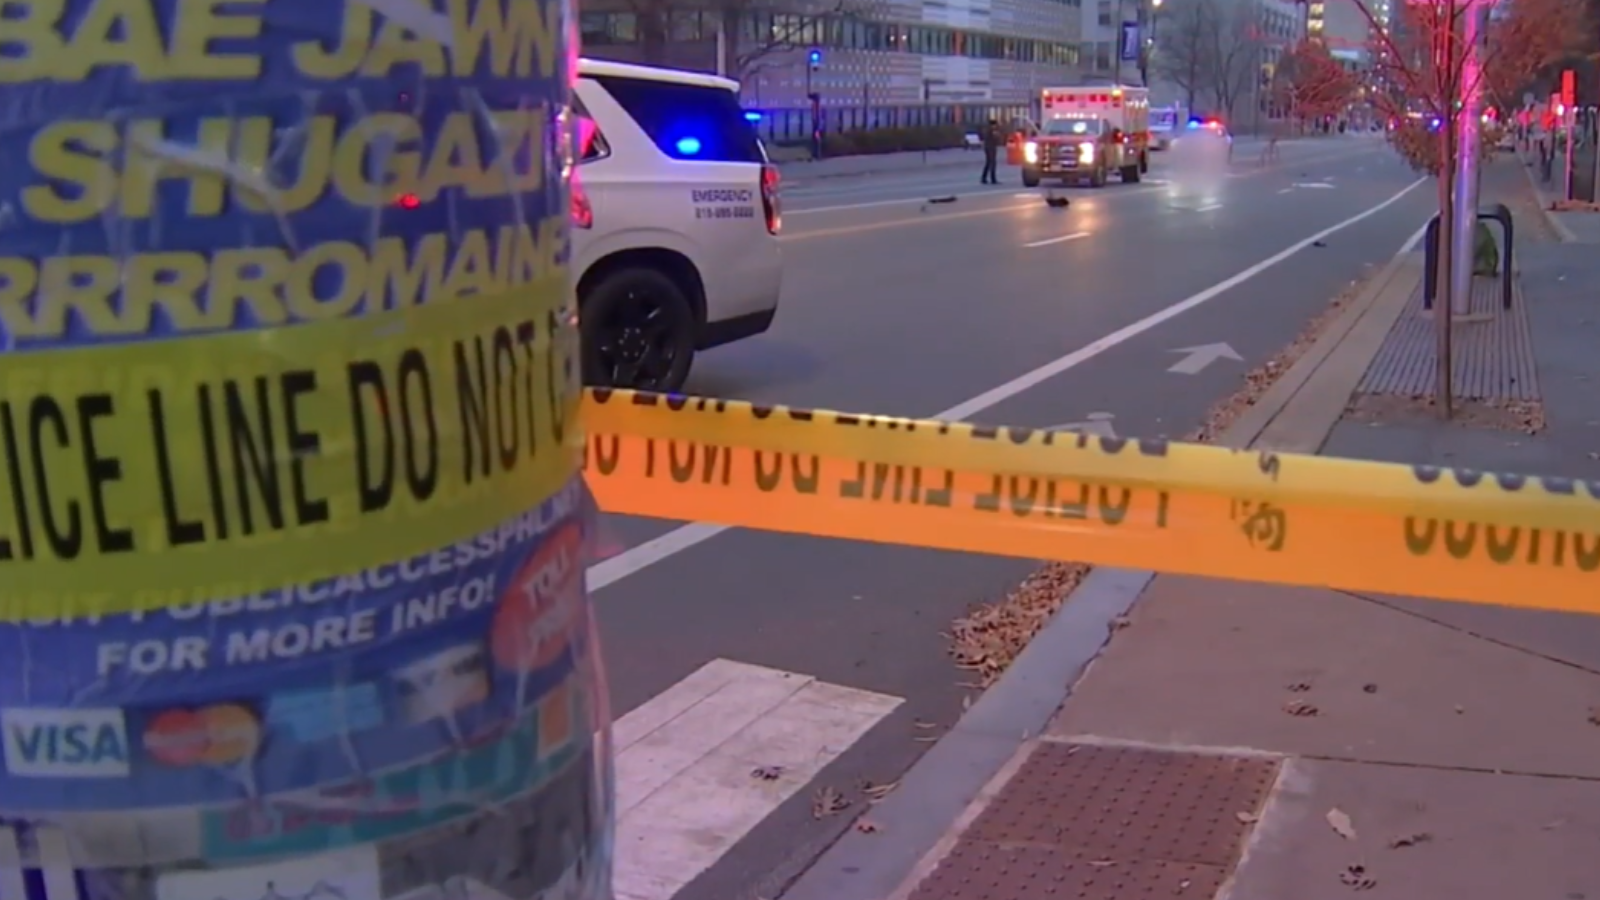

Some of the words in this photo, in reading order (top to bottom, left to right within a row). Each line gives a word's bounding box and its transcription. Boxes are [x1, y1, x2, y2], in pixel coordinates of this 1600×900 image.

[290, 0, 558, 78] JAWN
[21, 109, 543, 223] SHUGAZI
[691, 189, 754, 203] EMERGENCY
[0, 392, 133, 560] ICE
[147, 370, 330, 547] LINE
[347, 347, 439, 514] DO
[453, 317, 538, 485] NOT
[97, 635, 208, 677] FOR
[226, 609, 377, 665] MORE
[391, 572, 496, 632] INFO!
[10, 723, 125, 765] VISA
